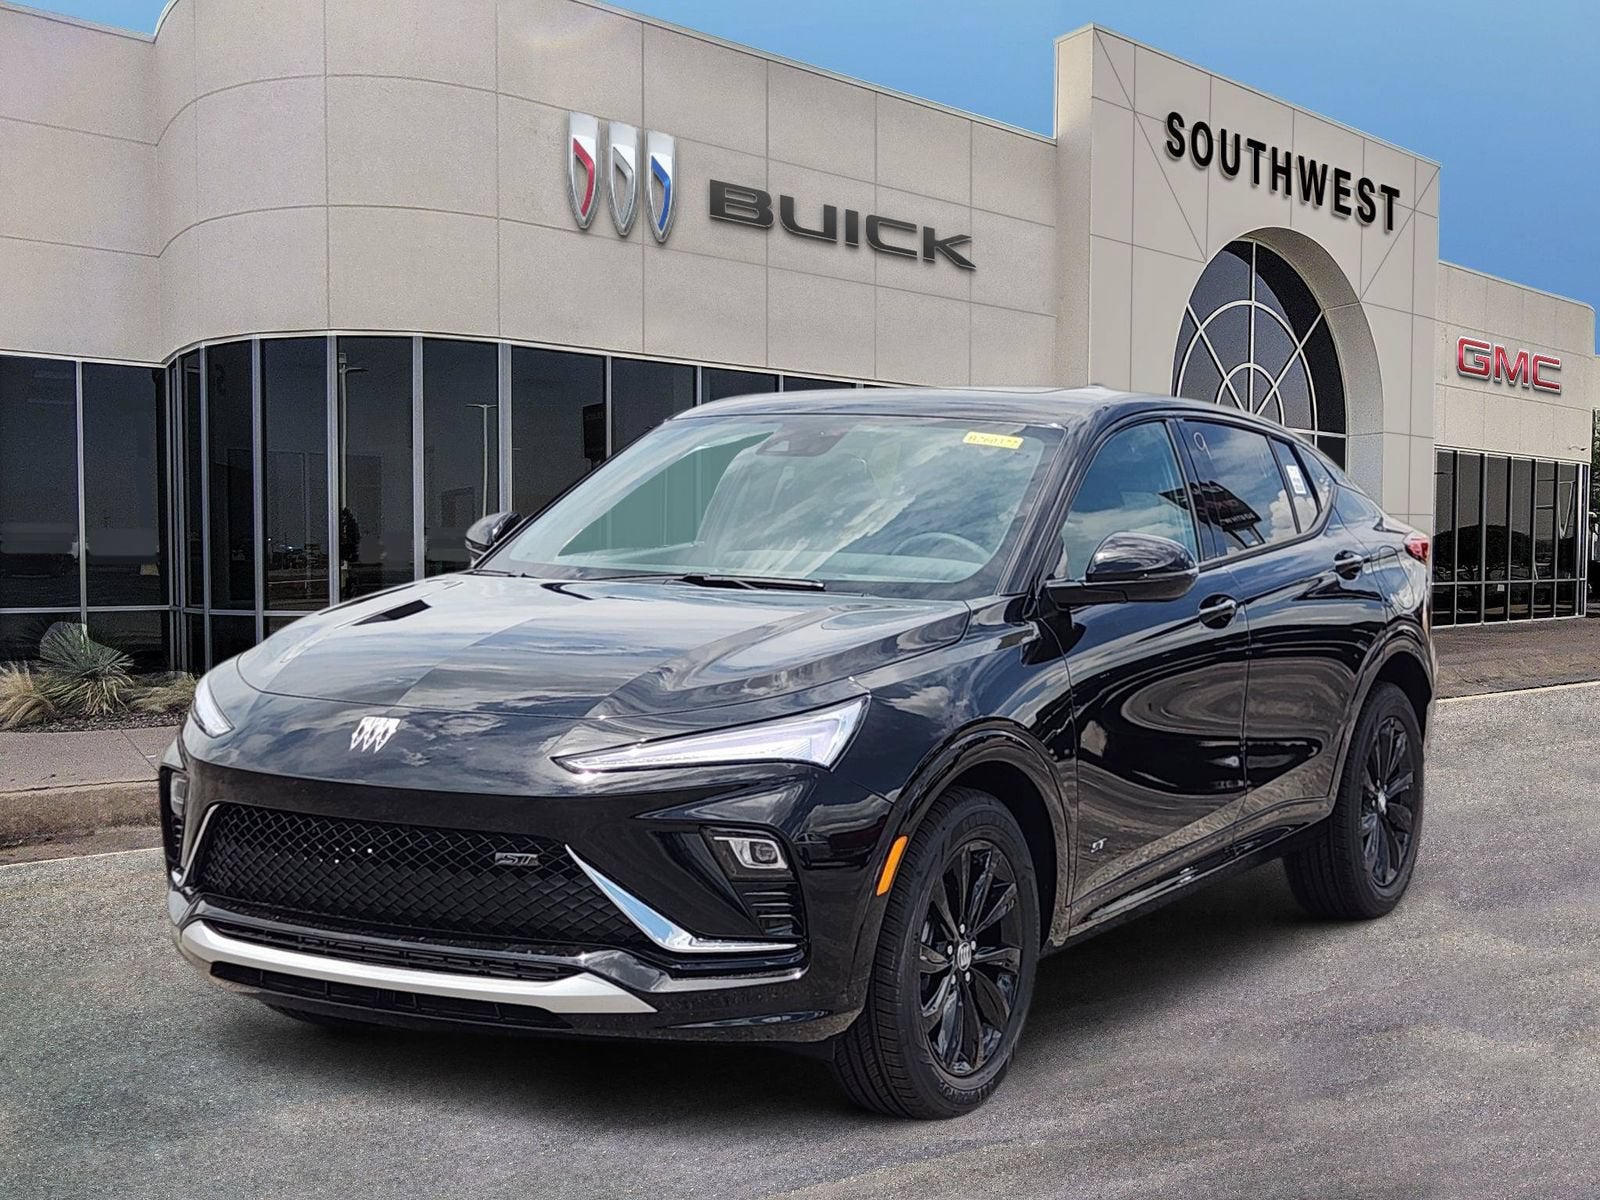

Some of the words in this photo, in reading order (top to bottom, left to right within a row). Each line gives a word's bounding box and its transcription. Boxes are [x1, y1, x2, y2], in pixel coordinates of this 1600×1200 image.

[1165, 111, 1400, 231] SOUTHWEST
[709, 179, 976, 270] BUICK
[1457, 336, 1562, 393] GMC
[498, 853, 538, 866] ST
